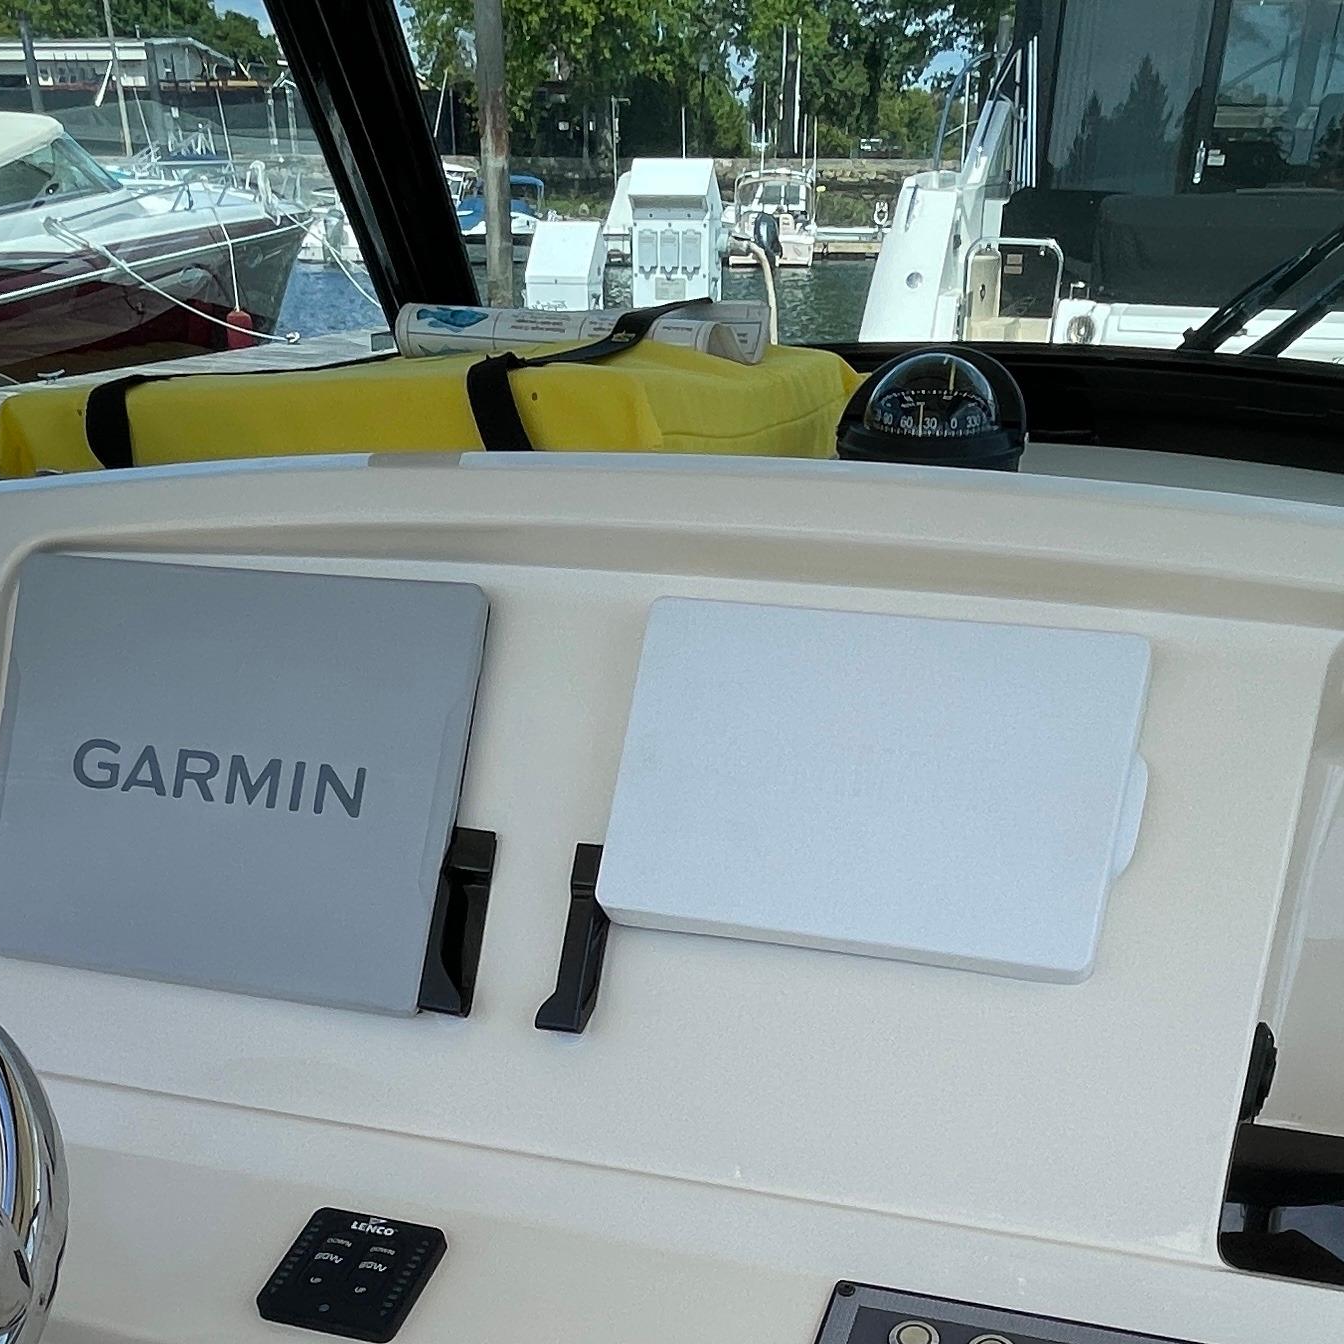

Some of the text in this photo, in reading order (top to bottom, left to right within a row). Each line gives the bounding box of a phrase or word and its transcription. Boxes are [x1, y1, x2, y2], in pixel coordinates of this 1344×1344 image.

[900, 415, 914, 429] 60
[923, 417, 937, 430] 30
[72, 738, 367, 819] GARMIN
[350, 1220, 395, 1236] LENCO
[314, 1252, 343, 1264] BOW
[358, 1261, 387, 1272] BOW
